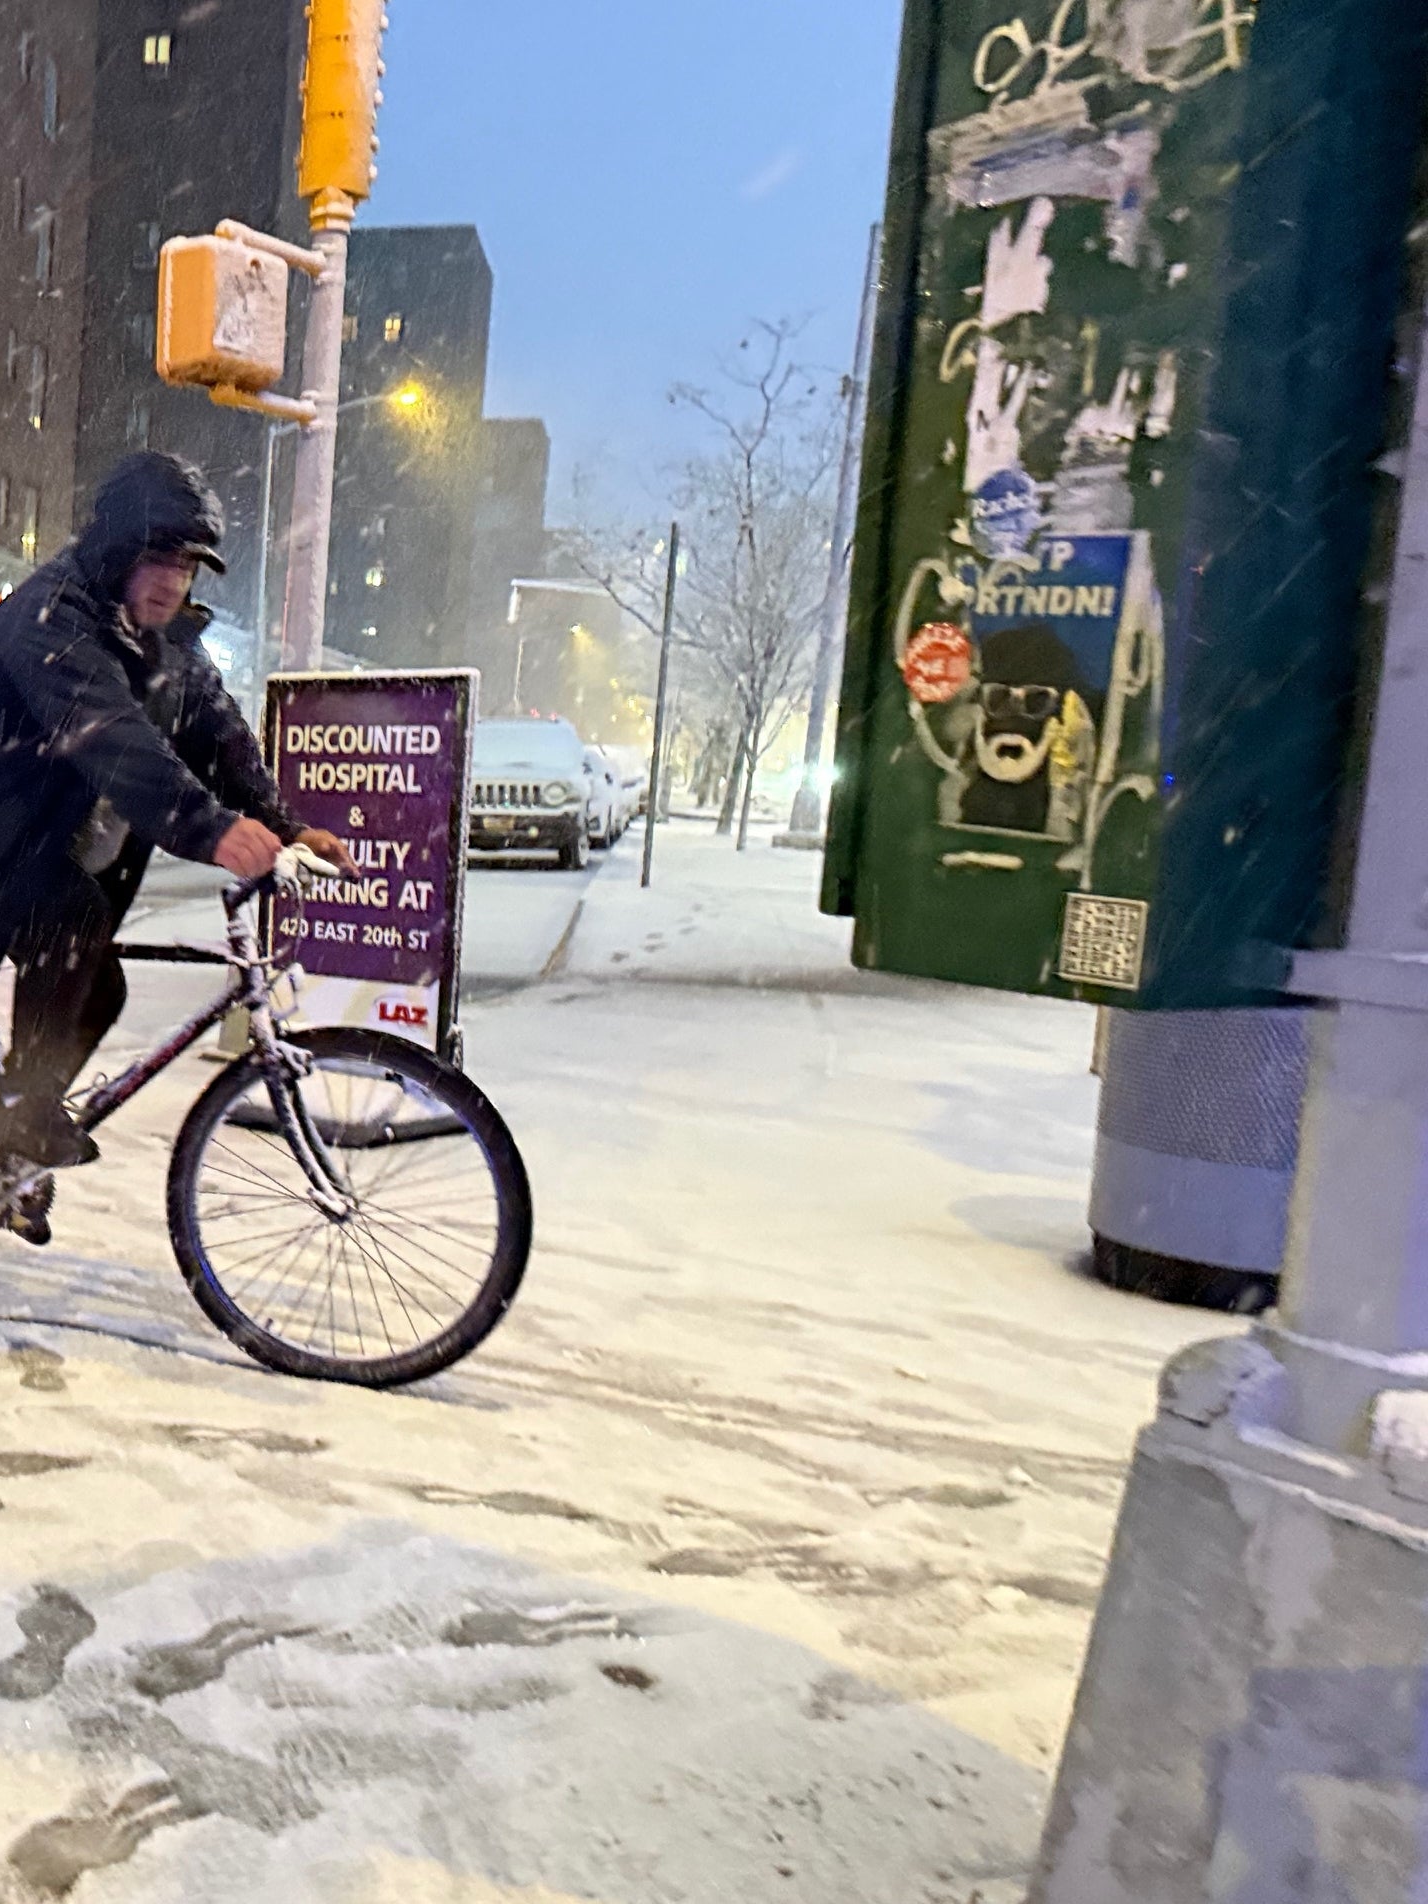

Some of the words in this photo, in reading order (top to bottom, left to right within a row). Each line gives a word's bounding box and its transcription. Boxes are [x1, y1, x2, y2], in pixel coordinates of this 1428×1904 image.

[286, 724, 441, 755] DISCOUNTED
[299, 762, 422, 793] HOSPITAL
[349, 805, 366, 828] &
[340, 838, 411, 871] ULTY
[280, 877, 389, 908] RKING
[397, 880, 435, 911] AT
[279, 917, 309, 939] 420
[314, 921, 358, 943] EAST
[362, 924, 402, 948] 20th
[408, 929, 430, 951] ST
[379, 1002, 428, 1027] LAZ
